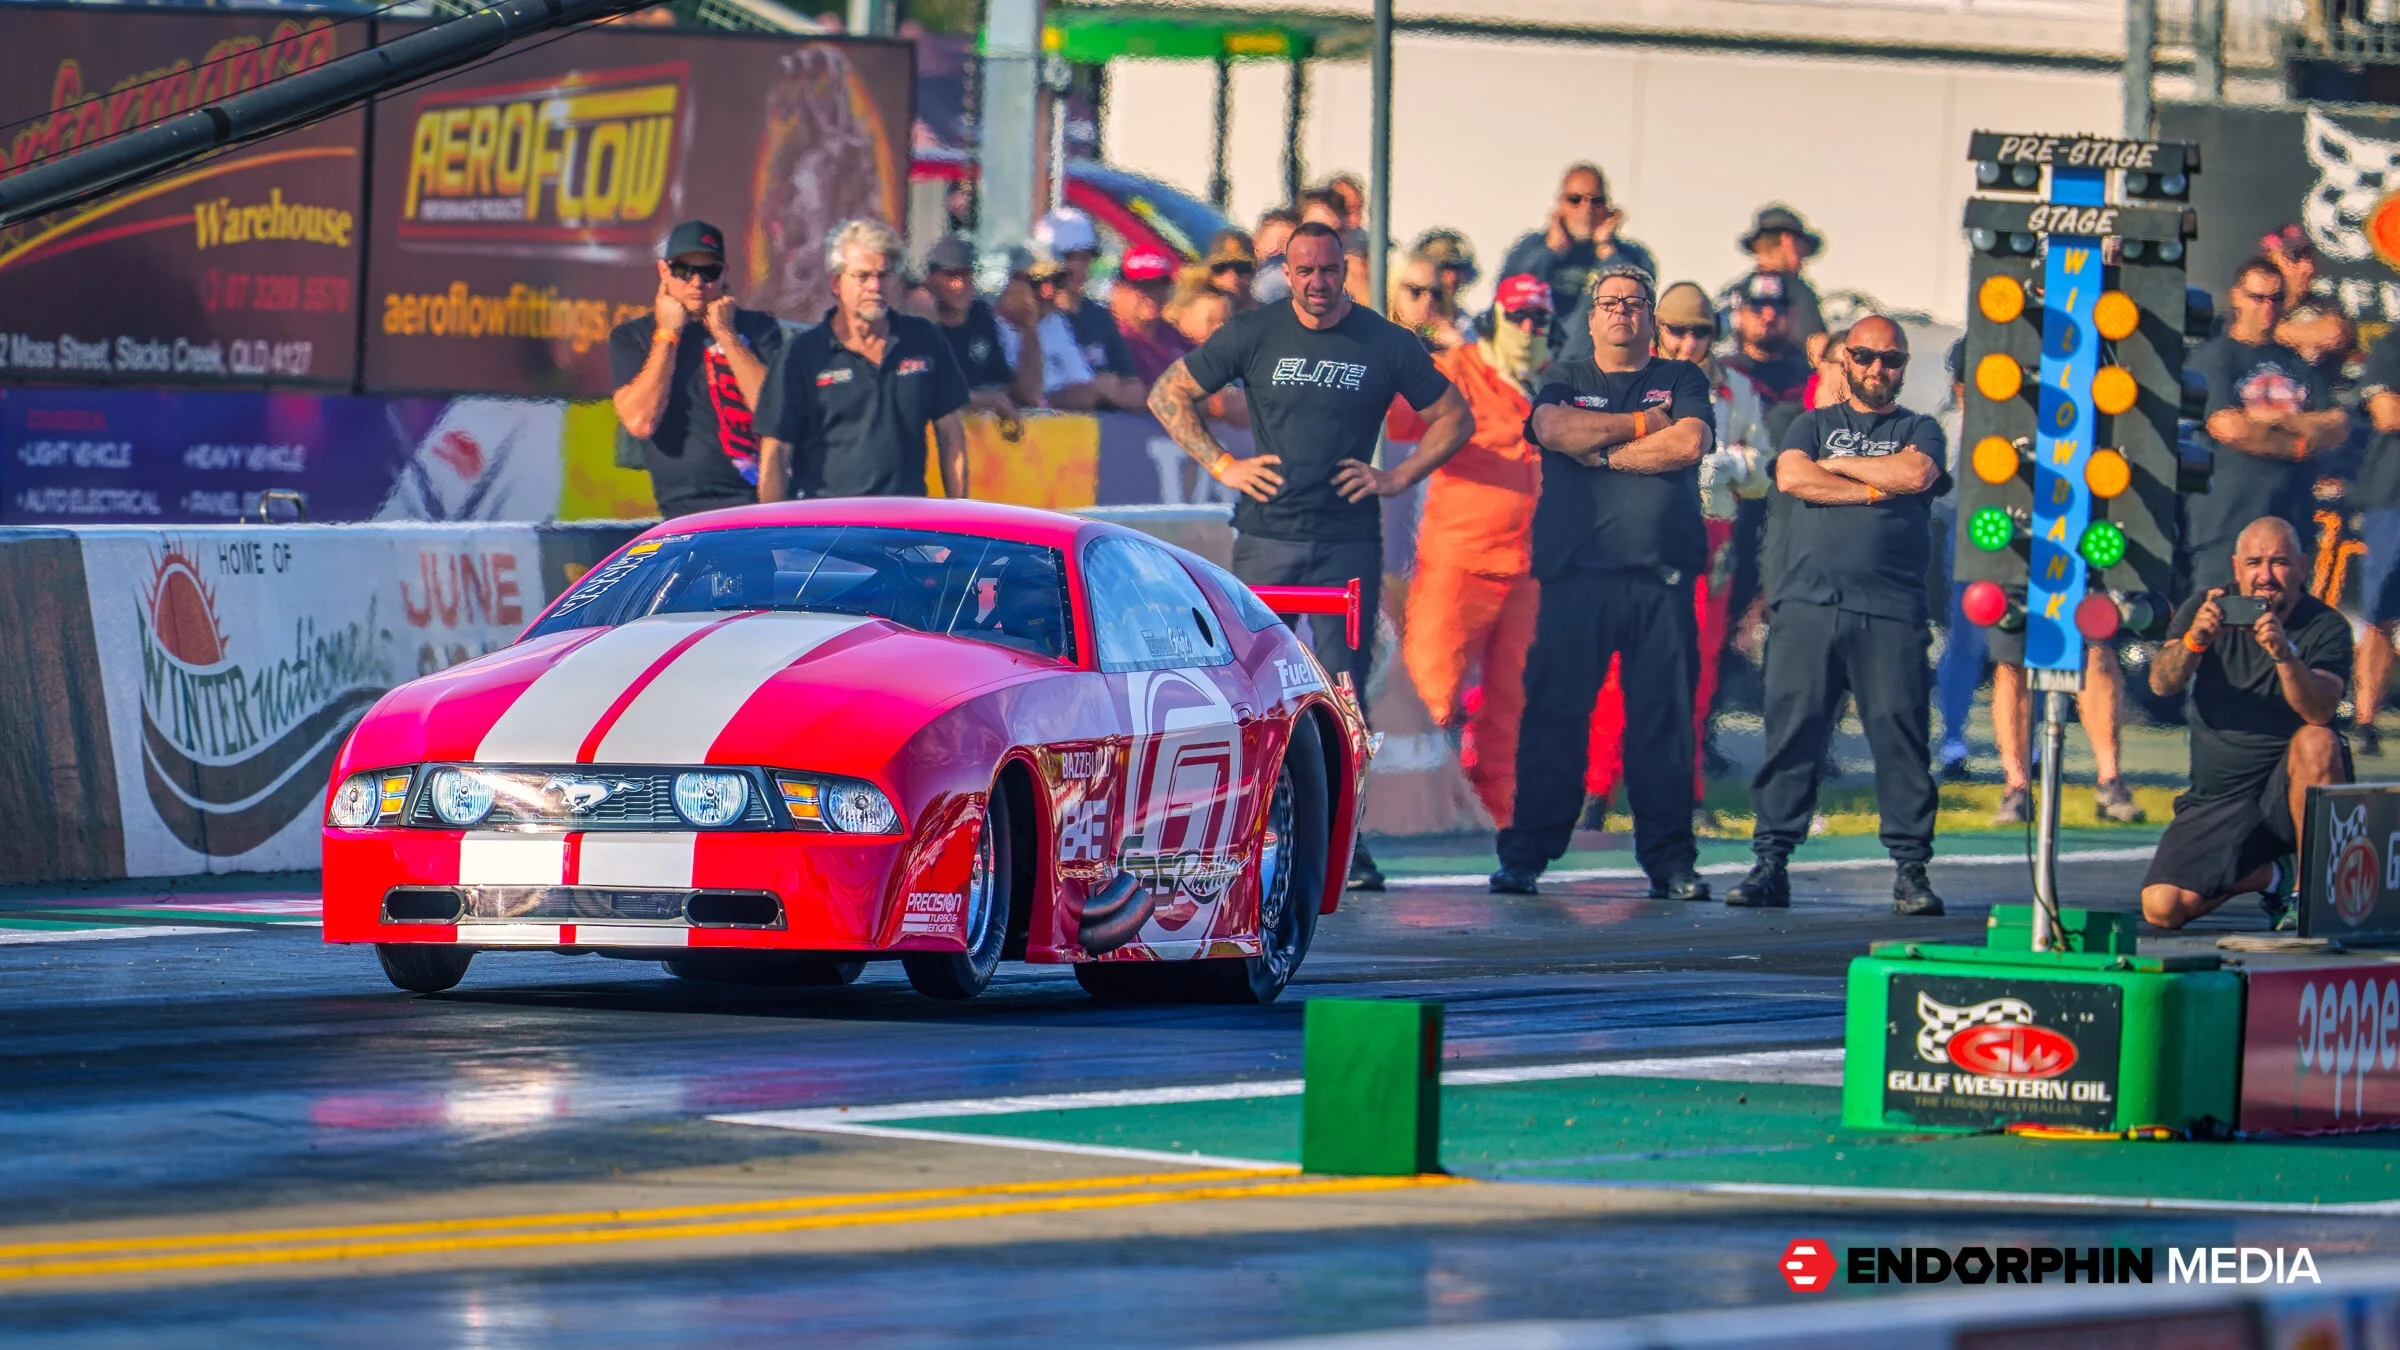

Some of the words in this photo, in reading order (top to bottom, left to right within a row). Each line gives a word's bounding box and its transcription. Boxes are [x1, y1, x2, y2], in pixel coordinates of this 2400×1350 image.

[403, 84, 678, 221] AEROFLOW
[1998, 136, 2158, 168] PRE-STAGE
[194, 187, 353, 249] Warehouse
[2027, 205, 2119, 234] STAGE
[1272, 358, 1367, 386] ELITE
[219, 543, 265, 575] HOME
[273, 542, 293, 573] OF
[399, 551, 523, 629] JUNE
[905, 892, 962, 913] PRECISION
[930, 913, 952, 923] TURBO
[928, 923, 955, 933] ENGINE
[1962, 1030, 2063, 1074] GW
[2294, 977, 2400, 1121] peppe
[1888, 1070, 1951, 1093] GULF
[1952, 1074, 2068, 1101] WESTERN
[2070, 1081, 2112, 1103] OIL
[1990, 1101, 2083, 1116] AUSTRALIAN
